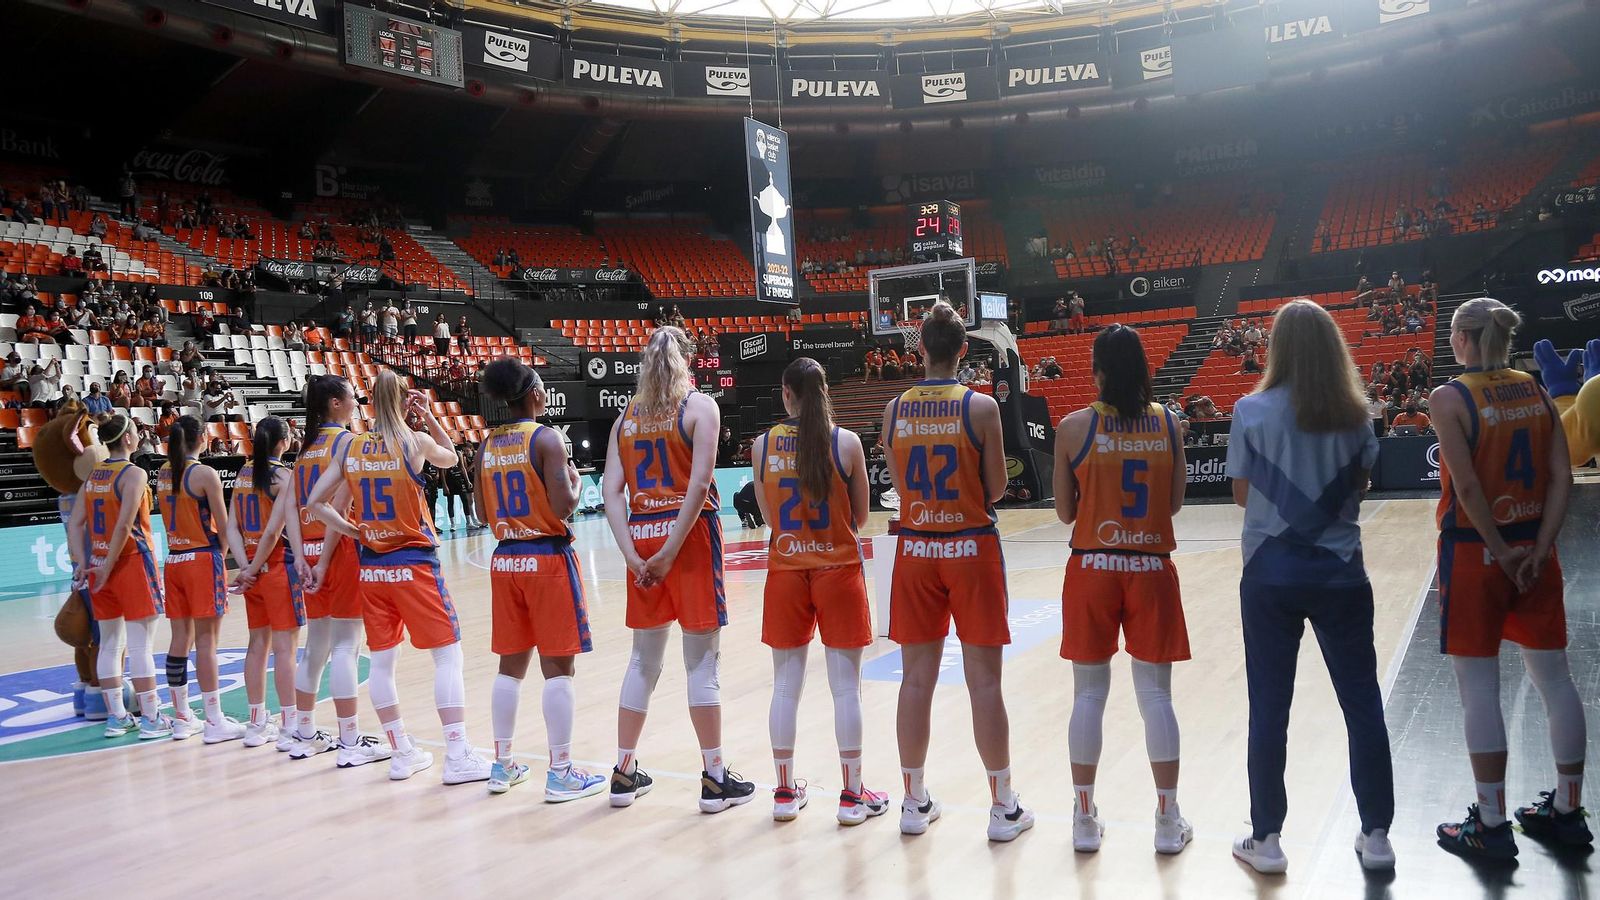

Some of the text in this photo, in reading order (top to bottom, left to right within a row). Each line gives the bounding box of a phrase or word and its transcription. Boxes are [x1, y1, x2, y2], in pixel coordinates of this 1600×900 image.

[488, 34, 528, 54] PULEVA
[1144, 50, 1170, 63] PULE
[572, 59, 664, 88] PULEVA
[708, 69, 748, 80] PULEVA
[1008, 62, 1100, 87] PULEVA
[791, 78, 880, 97] PULEVA
[924, 76, 964, 88] PULEVA
[911, 171, 975, 193] isaval
[916, 217, 940, 236] 24
[523, 268, 559, 281] Coca-Cola
[595, 268, 629, 281] Coca-Cola
[763, 273, 794, 288] SUPERCOPA
[1153, 276, 1185, 289] aiken
[199, 291, 214, 300] 109
[772, 287, 793, 299] ENDESA
[417, 305, 430, 315] 108
[637, 302, 649, 310] 107
[743, 337, 763, 348] Oscar
[814, 341, 834, 349] travel
[743, 345, 764, 356] Mayer
[614, 361, 643, 375] Bert
[697, 358, 719, 368] 3:29
[720, 377, 733, 387] 00
[899, 399, 961, 418] RAMAN
[915, 420, 960, 435] isaval
[1117, 437, 1168, 452] isaval
[361, 458, 400, 471] isaval
[497, 450, 527, 466] isaval
[634, 438, 674, 490] 21
[1504, 427, 1537, 490] 4
[905, 444, 960, 501] 42
[492, 470, 530, 518] 18
[1120, 459, 1149, 519] 5
[359, 477, 395, 521] 15
[93, 499, 105, 535] 6
[166, 495, 177, 531] 7
[238, 493, 261, 532] 10
[915, 509, 964, 524] Midea
[1510, 502, 1543, 519] Mide
[365, 528, 404, 542] Midea
[503, 527, 541, 540] Midea
[1109, 529, 1162, 545] Midea
[786, 541, 834, 553] Midea
[902, 539, 978, 559] PAMESA
[1081, 553, 1164, 573] PAMESA
[360, 568, 414, 583] PAMESA
